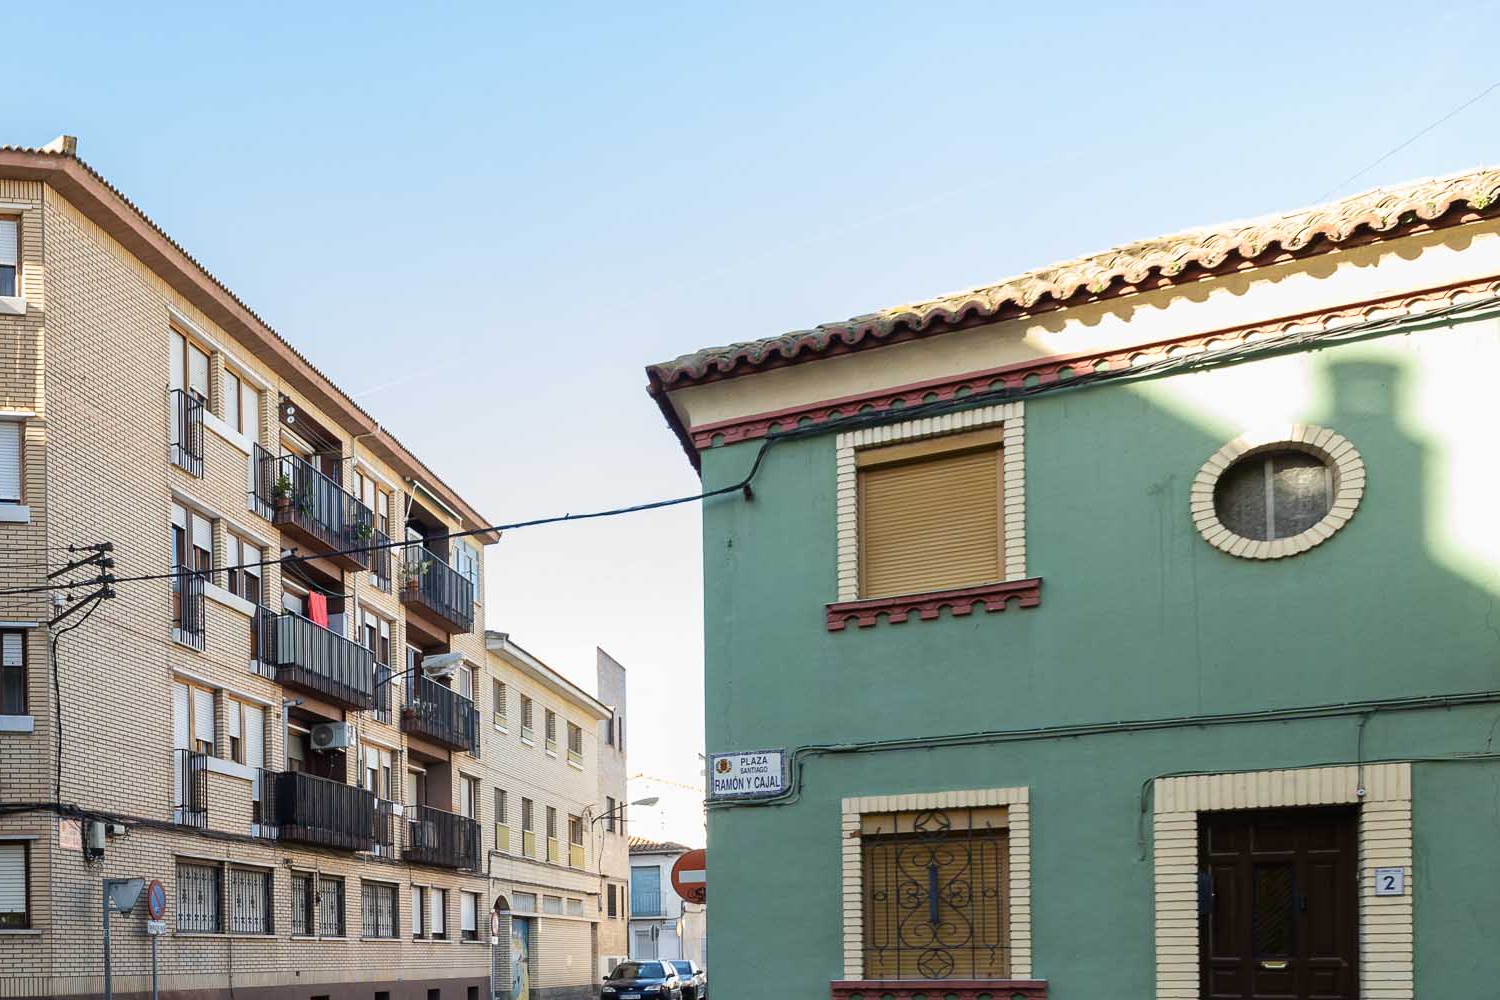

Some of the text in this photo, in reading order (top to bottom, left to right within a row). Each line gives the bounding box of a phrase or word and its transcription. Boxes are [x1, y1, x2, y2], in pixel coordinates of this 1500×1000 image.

[740, 756, 768, 766] PLAZA
[740, 766, 768, 774] SANTIAGO
[715, 776, 781, 791] RAMÓN Y CAJAL
[1383, 876, 1395, 890] 2
